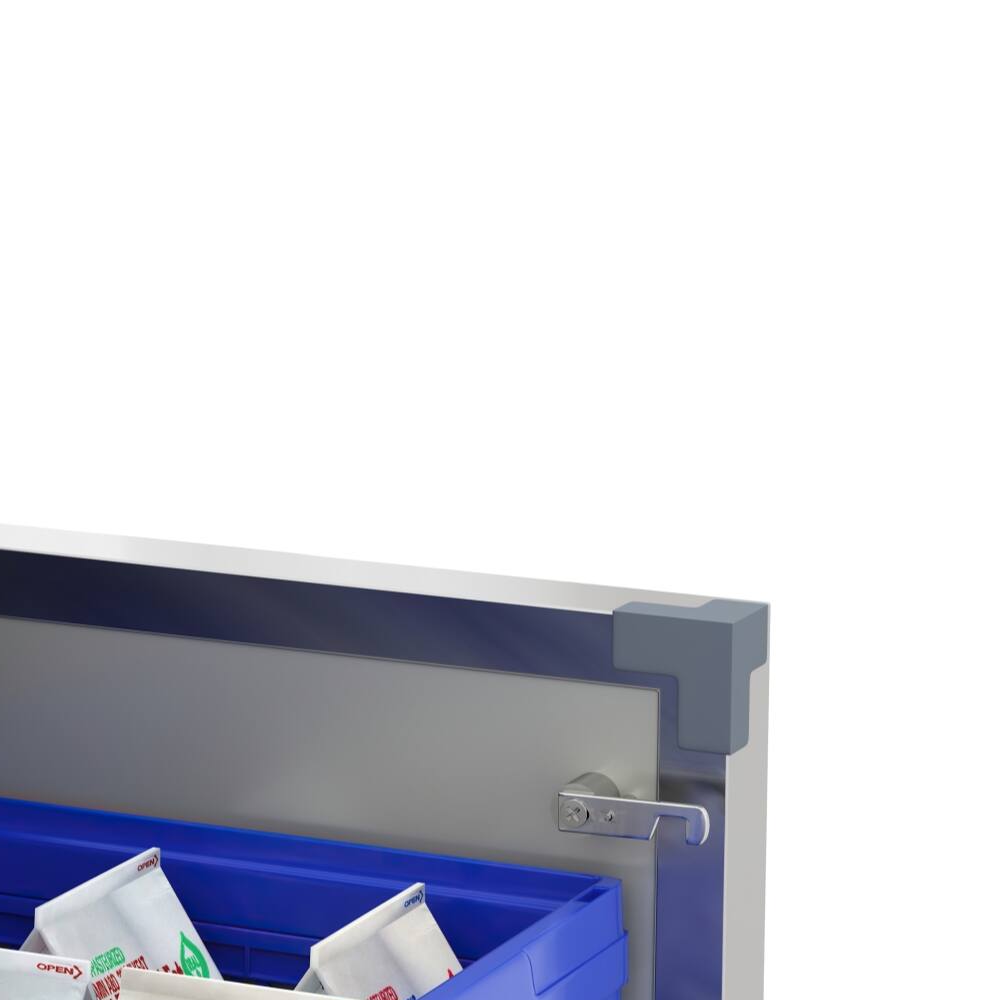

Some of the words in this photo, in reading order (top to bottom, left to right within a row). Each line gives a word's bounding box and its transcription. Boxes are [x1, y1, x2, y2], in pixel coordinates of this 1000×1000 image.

[137, 857, 156, 872] OPEN
[404, 890, 422, 908] OPEN
[36, 962, 75, 976] OPEN
